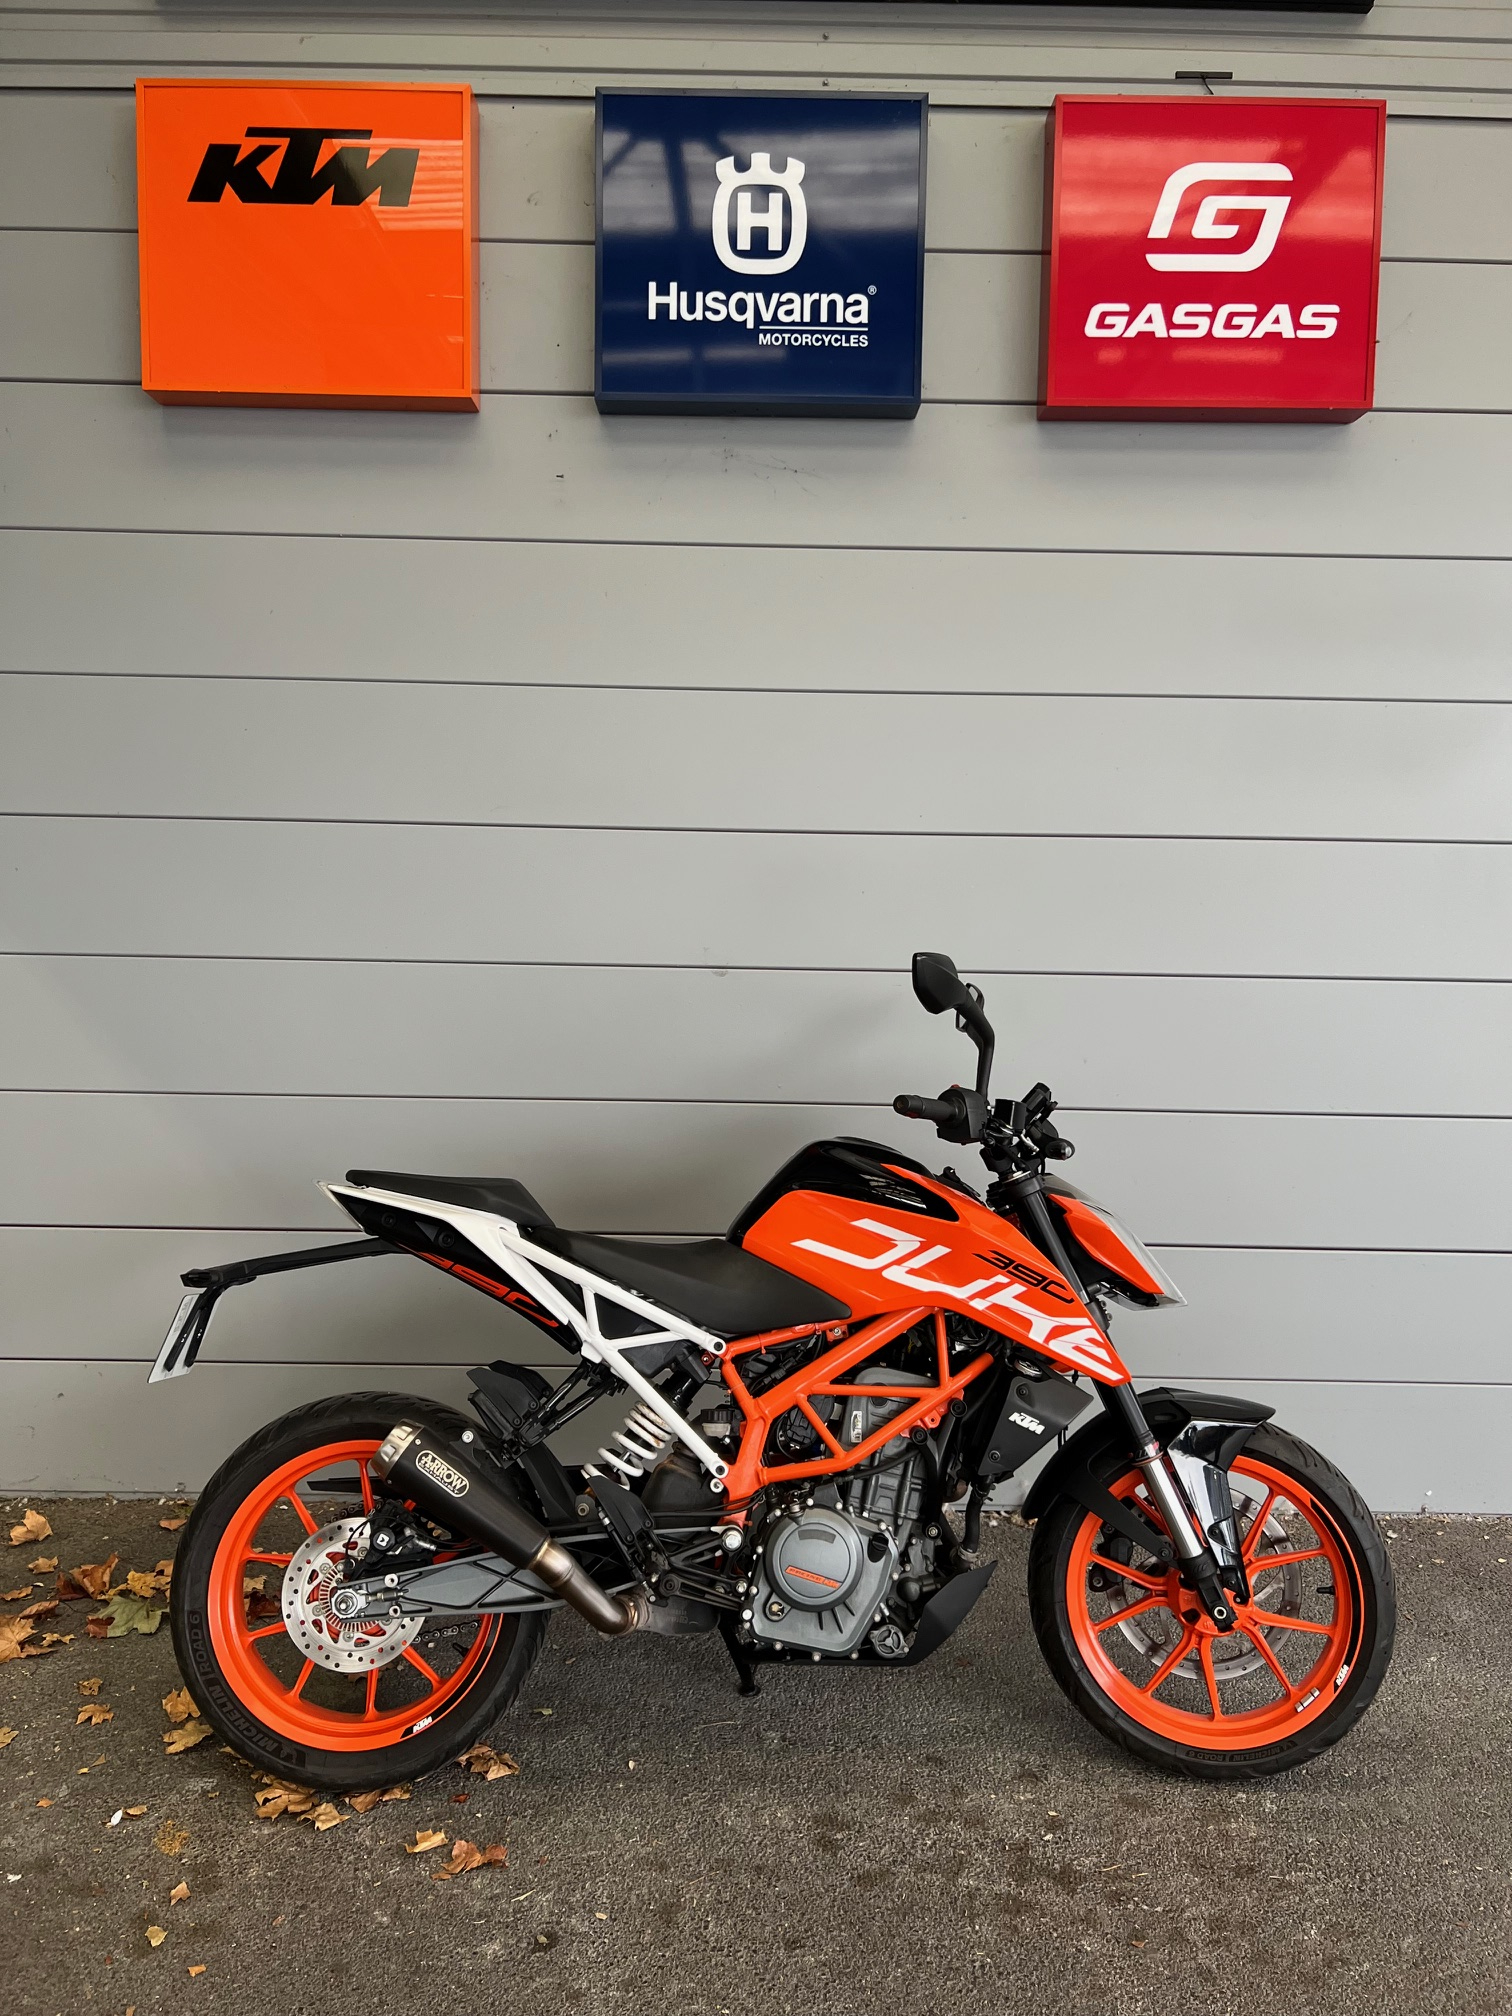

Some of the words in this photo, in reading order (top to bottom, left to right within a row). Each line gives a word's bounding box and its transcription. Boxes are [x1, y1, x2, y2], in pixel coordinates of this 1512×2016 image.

[187, 126, 420, 207] KTM
[1084, 302, 1341, 339] GASGAS
[758, 333, 869, 347] MOTORCYCLES
[790, 1218, 1124, 1381] DUKE
[1008, 1411, 1046, 1435] KTM
[420, 1453, 468, 1490] ARROW
[189, 1613, 201, 1625] 6
[191, 1627, 213, 1673] ROAD
[208, 1684, 280, 1751] MICHELIN
[412, 1715, 433, 1734] KTM
